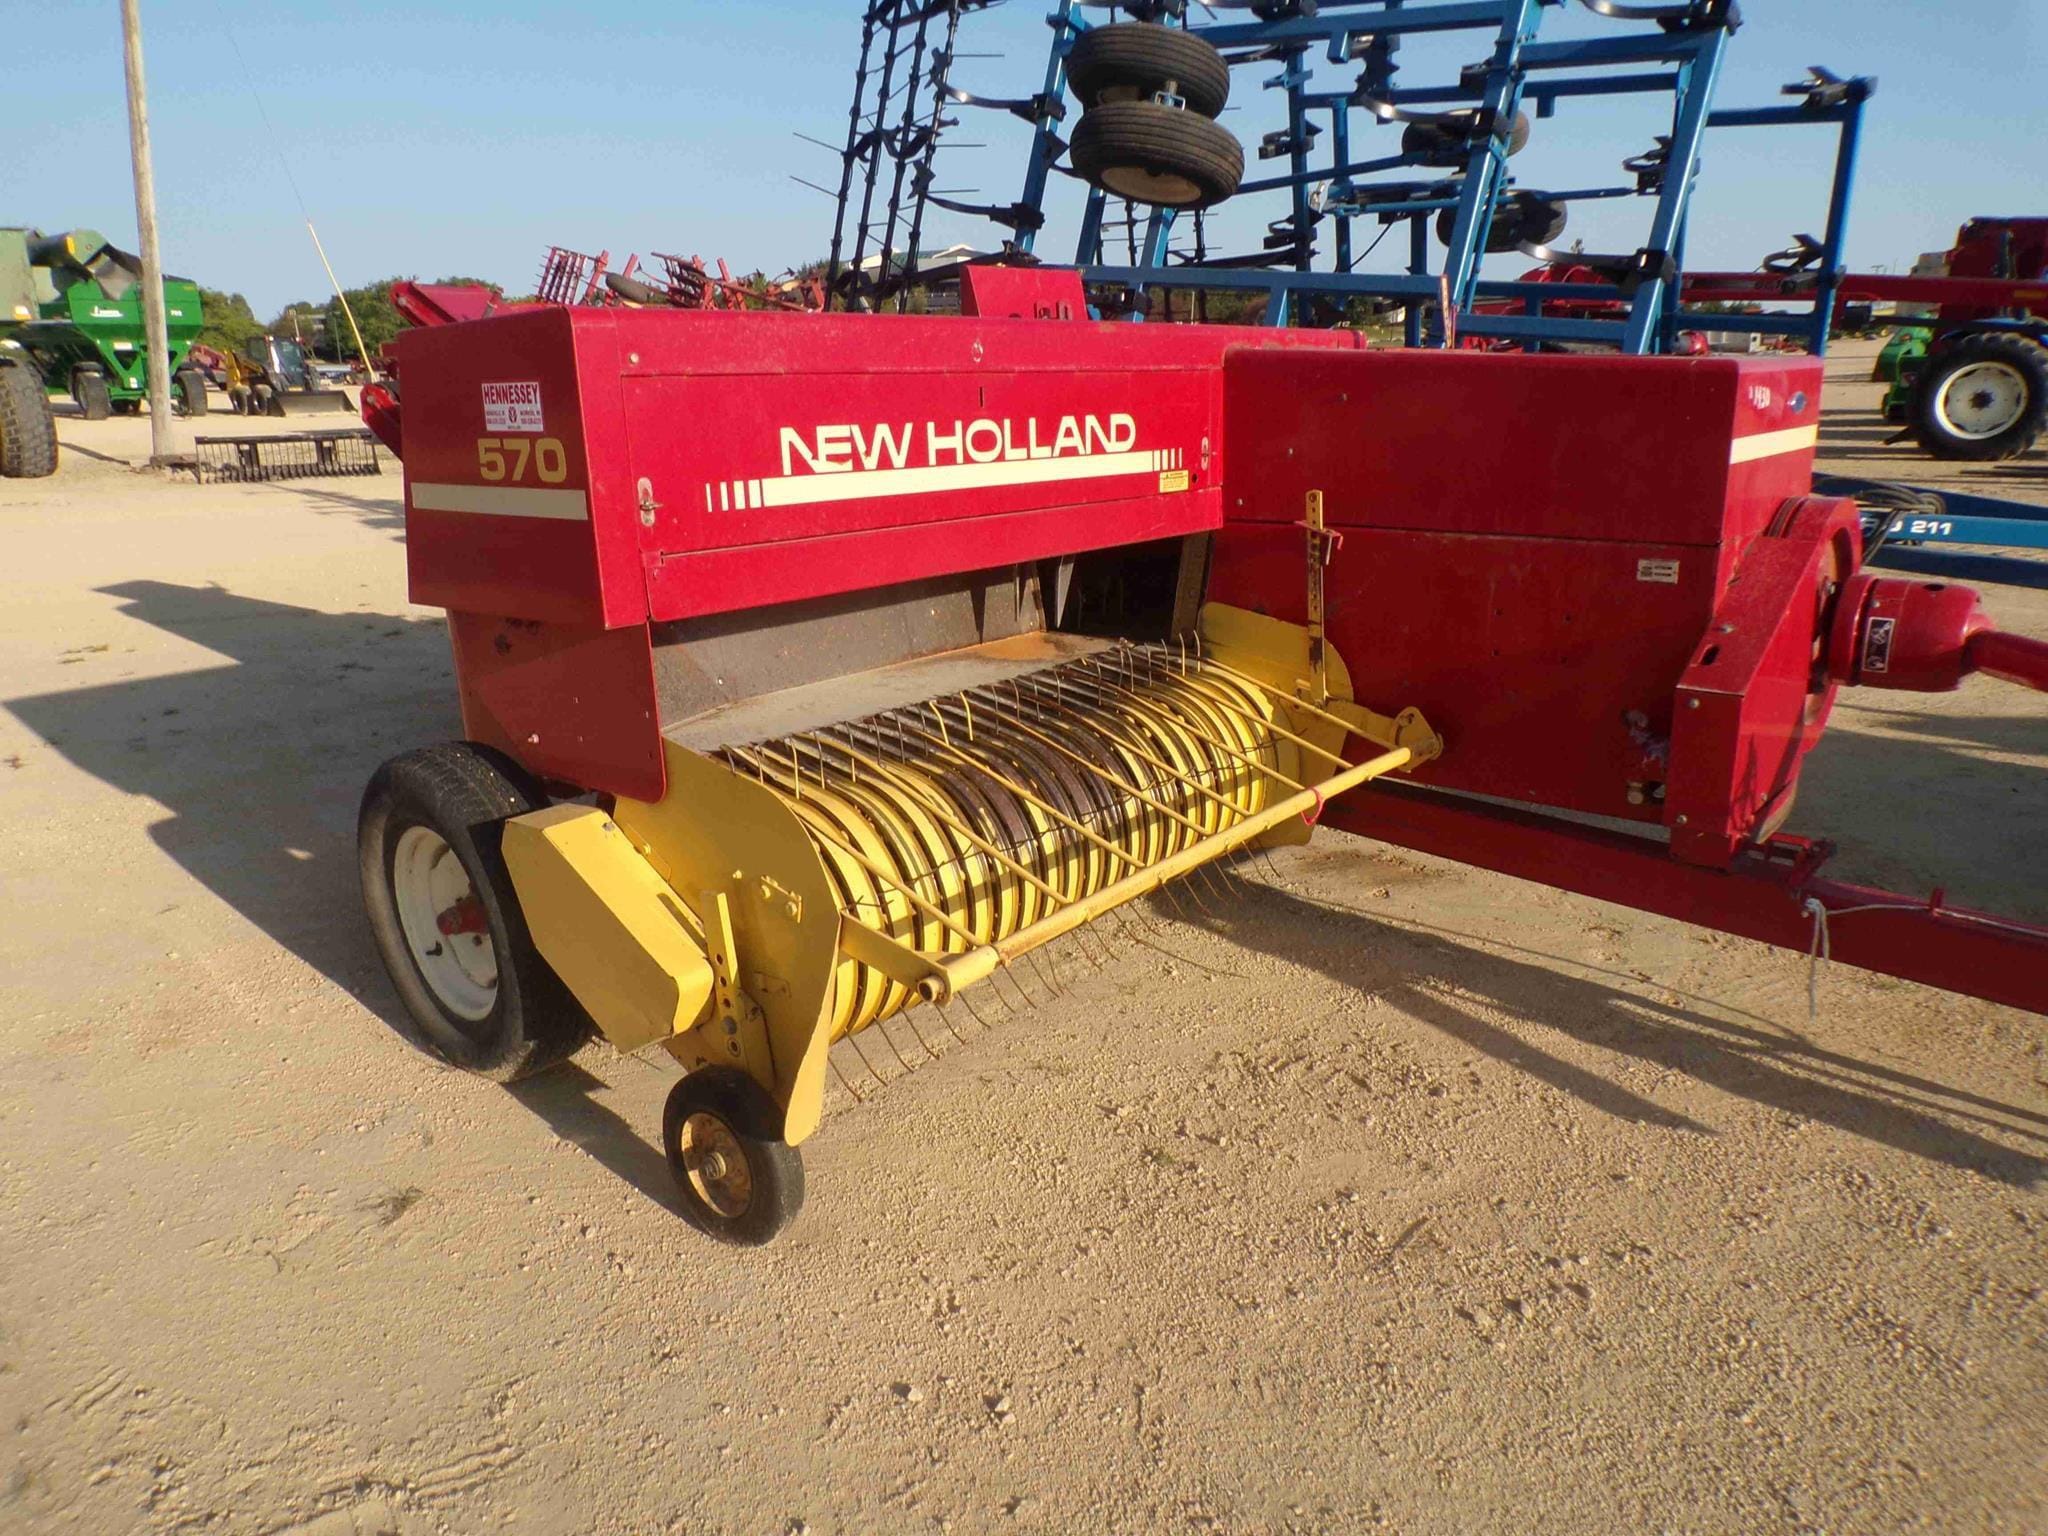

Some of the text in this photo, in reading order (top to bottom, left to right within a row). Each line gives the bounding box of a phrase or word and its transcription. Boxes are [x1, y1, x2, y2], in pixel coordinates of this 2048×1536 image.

[484, 384, 538, 404] HENNESSEY
[477, 437, 567, 483] 570
[779, 412, 1137, 476] NEW HOLLAND
[1909, 519, 1953, 536] 211
